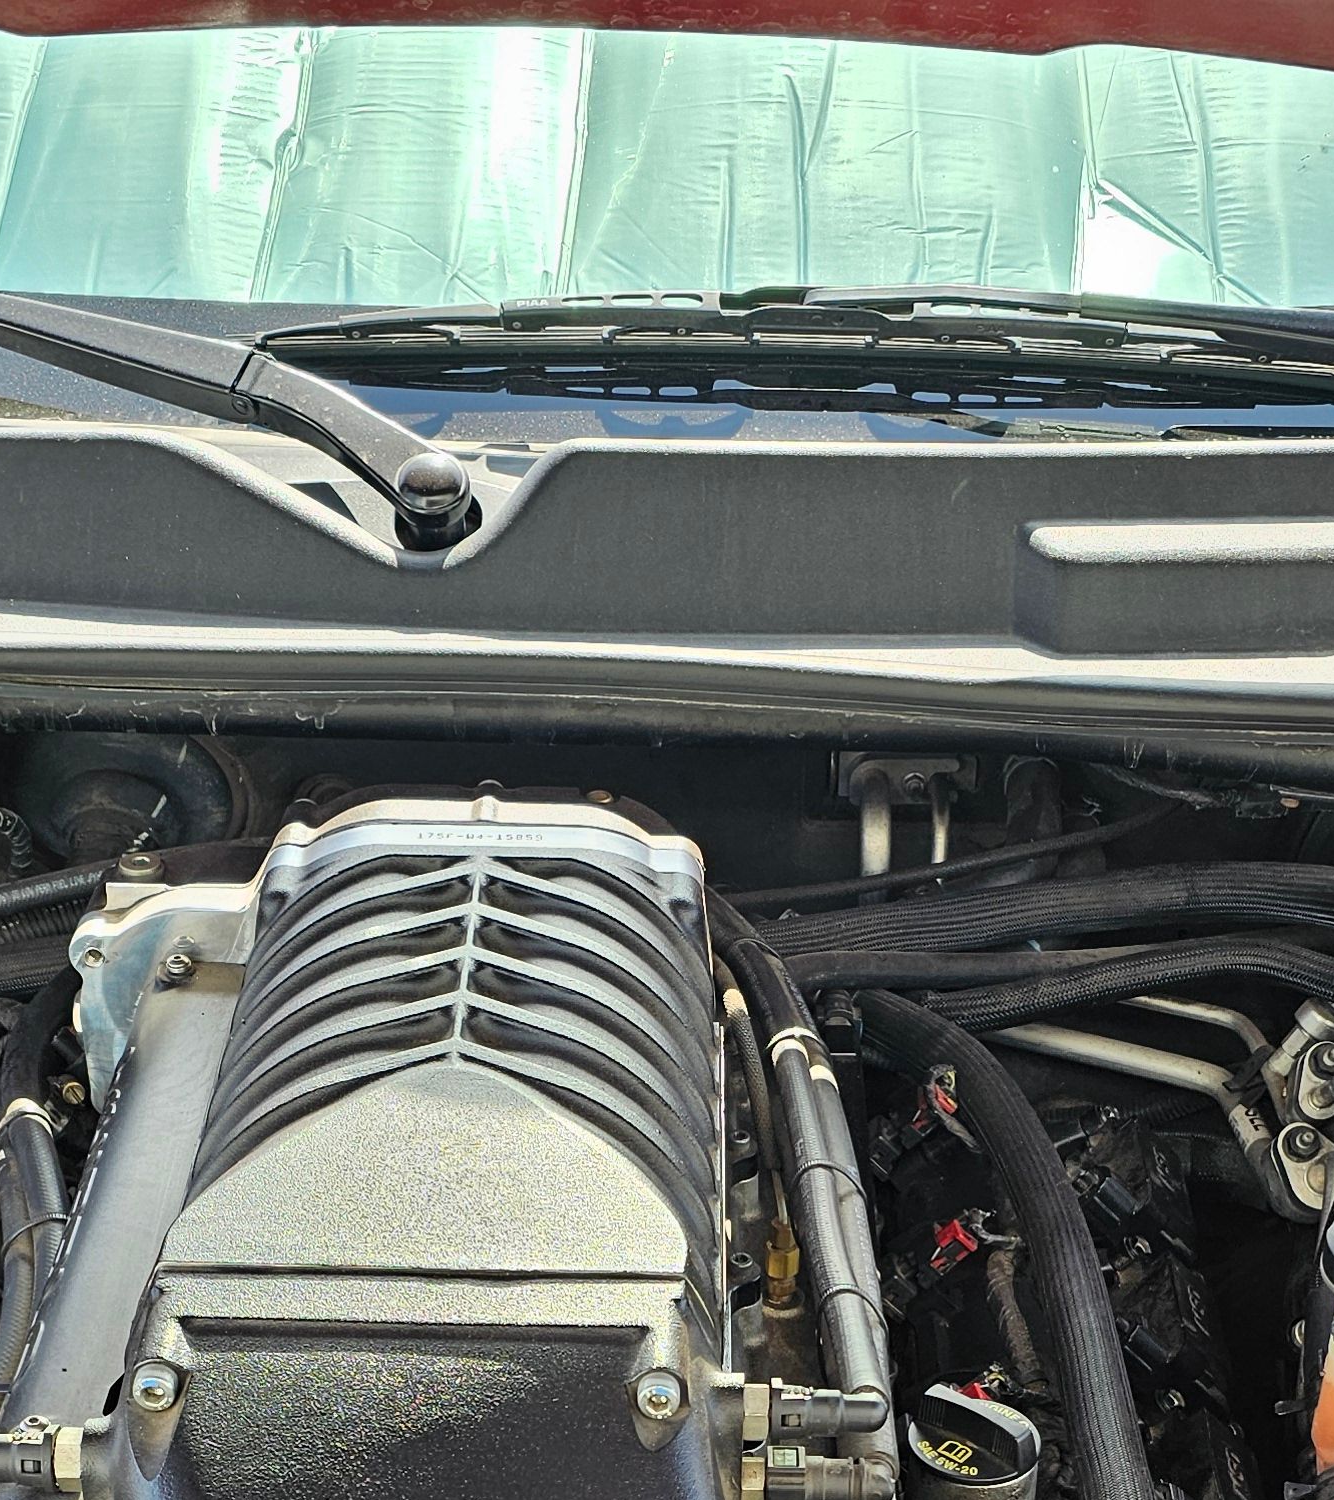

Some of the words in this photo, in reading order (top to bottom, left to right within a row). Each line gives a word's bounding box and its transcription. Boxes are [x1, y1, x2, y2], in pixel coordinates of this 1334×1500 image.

[516, 299, 549, 308] PIAA
[917, 1440, 939, 1460] SAE
[935, 1456, 979, 1476] 5W-20
